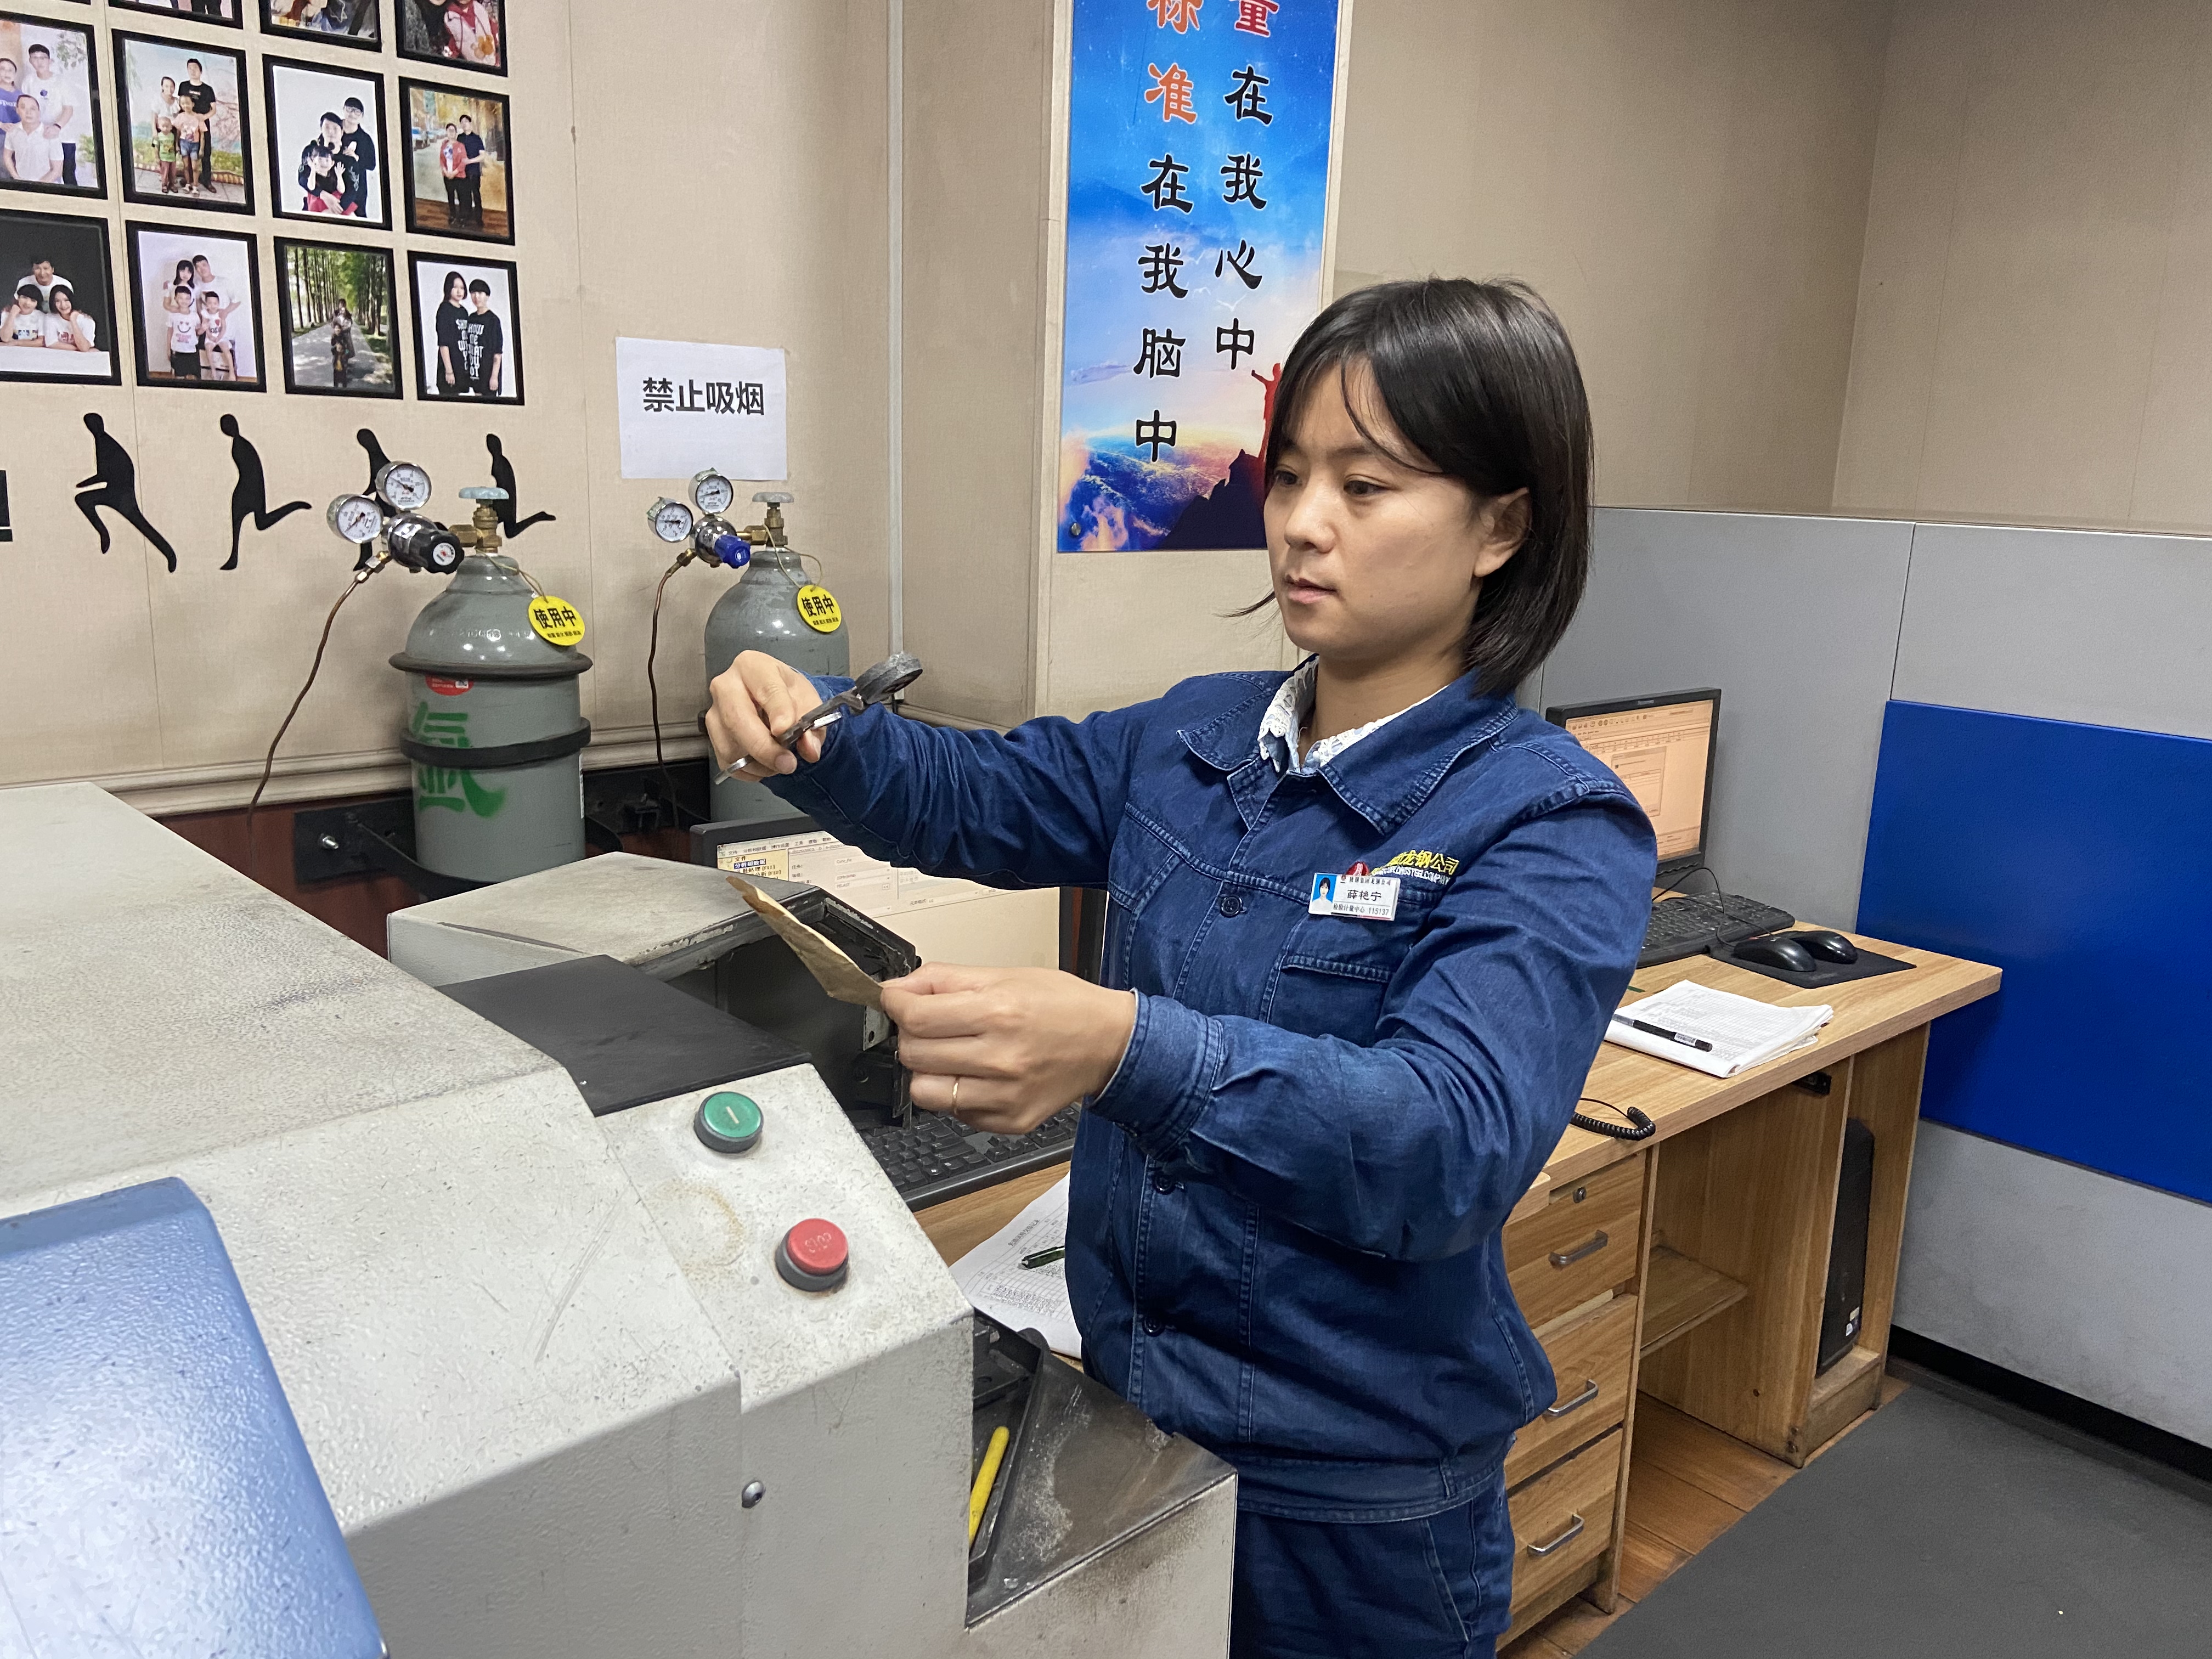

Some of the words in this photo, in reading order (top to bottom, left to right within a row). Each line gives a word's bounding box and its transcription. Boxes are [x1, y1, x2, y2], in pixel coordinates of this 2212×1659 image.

[642, 377, 764, 415] 禁止吸烟
[801, 594, 834, 617] 使用中
[533, 606, 577, 629] 使用中
[1368, 907, 1390, 916] 115137
